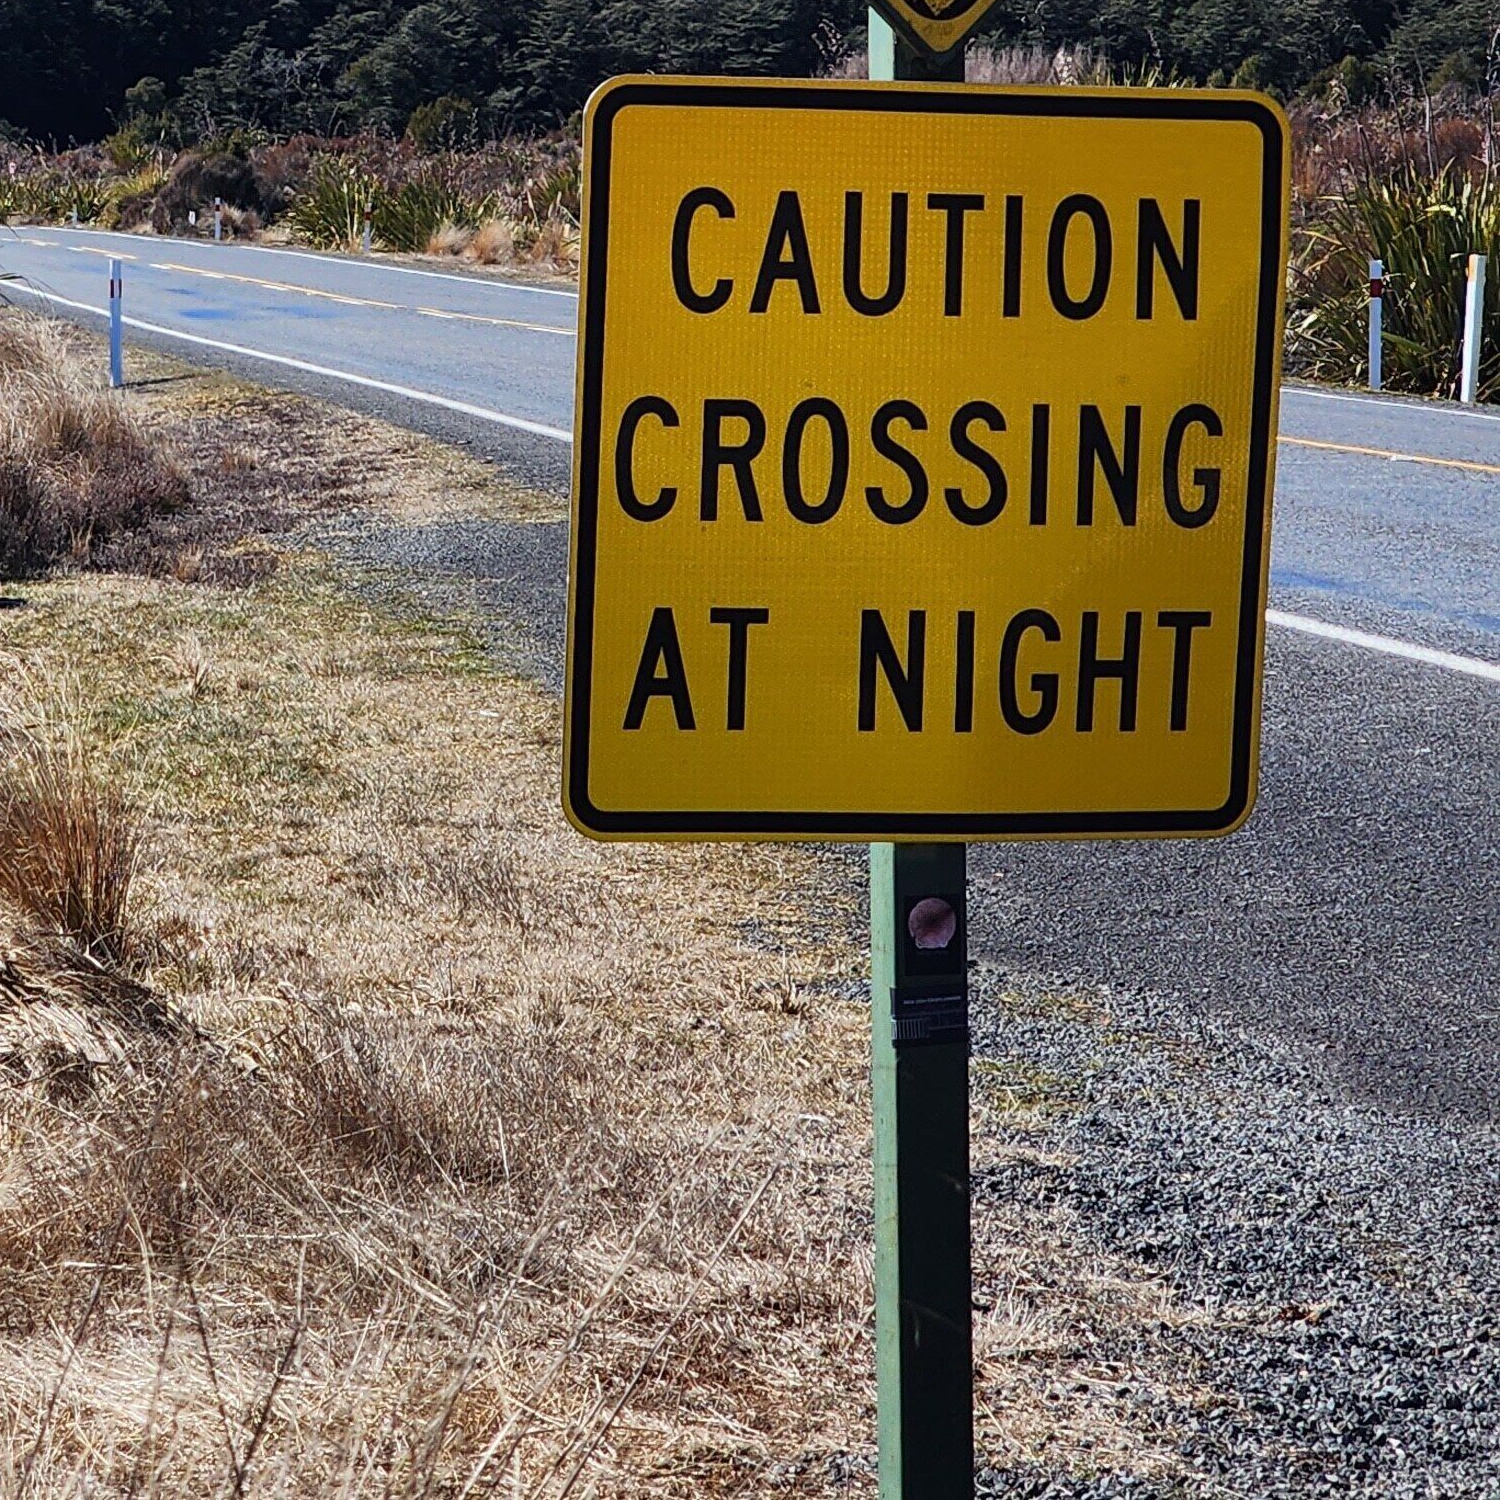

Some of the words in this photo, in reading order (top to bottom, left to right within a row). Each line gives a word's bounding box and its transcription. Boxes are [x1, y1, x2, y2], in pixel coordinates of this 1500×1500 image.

[671, 187, 1200, 321] CAUTION
[615, 395, 1223, 529] CROSSING
[623, 607, 769, 731] AT
[857, 609, 1211, 735] NIGHT
